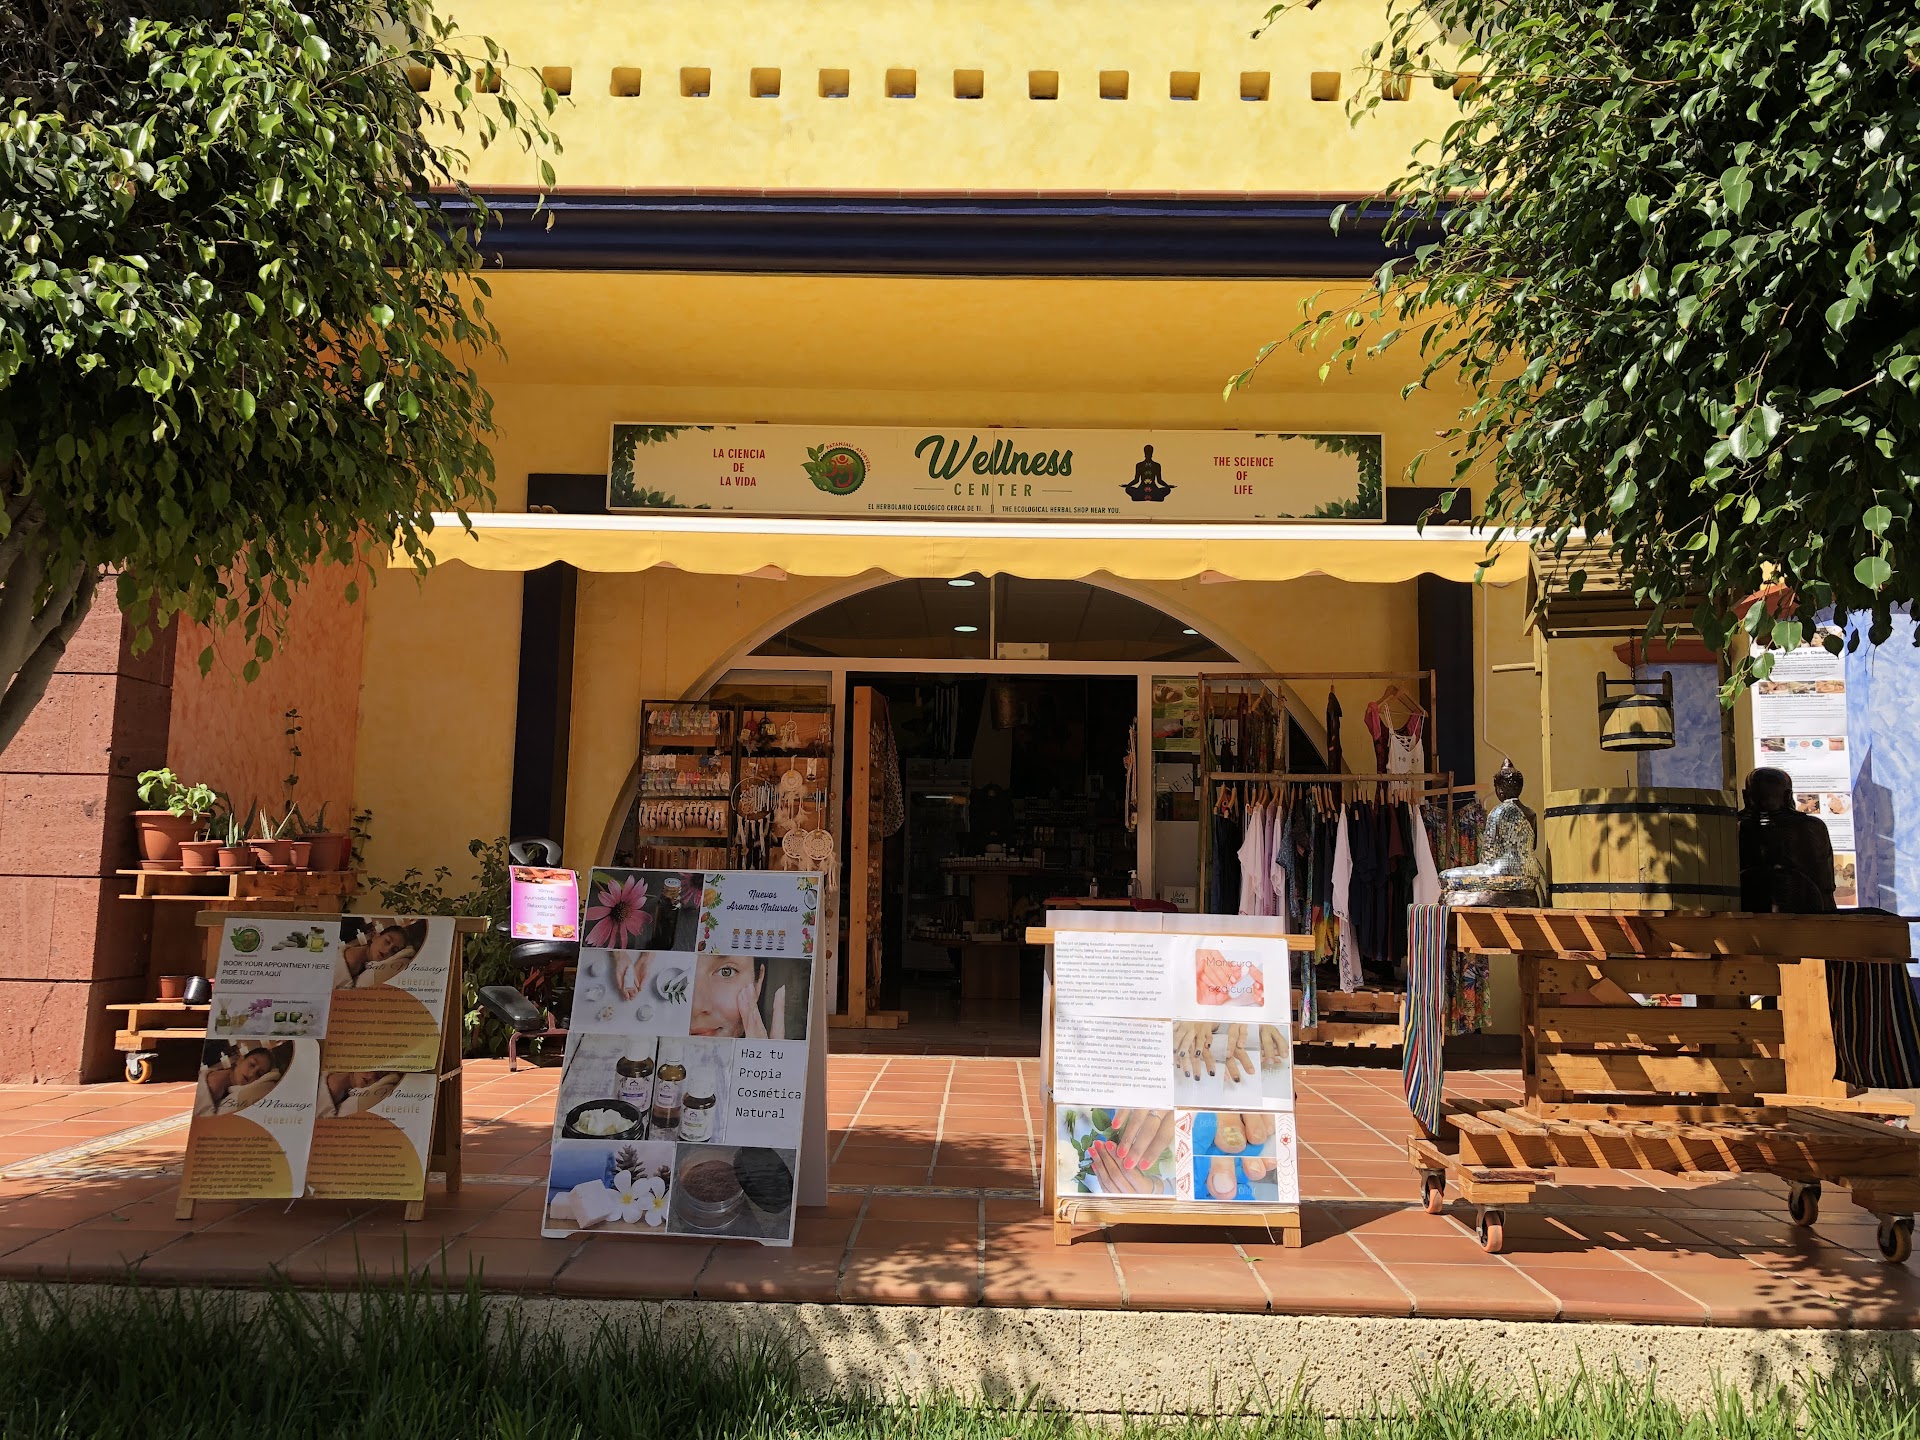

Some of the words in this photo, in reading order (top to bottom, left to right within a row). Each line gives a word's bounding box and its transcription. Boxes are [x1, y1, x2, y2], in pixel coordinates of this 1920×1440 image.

[826, 441, 854, 450] PATANJALI
[713, 448, 724, 458] LA
[728, 448, 766, 459] CIENCIA
[855, 447, 872, 472] AYURVEDA
[914, 434, 1073, 480] Wellness
[733, 462, 745, 472] DE
[1214, 456, 1230, 466] THE
[1234, 457, 1274, 467] SCIENCE
[720, 476, 732, 486] LA
[735, 476, 756, 486] VIDA
[1236, 471, 1248, 480] OF
[954, 482, 1032, 497] CENTER
[1234, 485, 1253, 494] LIFE
[914, 503, 945, 511] ECOLÓGICO
[748, 890, 778, 899] Nuevos
[726, 901, 759, 912] Aromas
[761, 901, 798, 913] Naturales
[365, 961, 386, 970] Bali
[390, 962, 447, 974] Massage
[741, 1048, 762, 1059] Haz
[770, 1049, 784, 1060] tu
[739, 1068, 782, 1080] Propia
[348, 1088, 370, 1097] Bali
[374, 1088, 433, 1102] Massage
[737, 1087, 802, 1100] Cosmética
[220, 1098, 248, 1107] Bali
[254, 1099, 312, 1111] Massage
[735, 1107, 785, 1119] Natural
